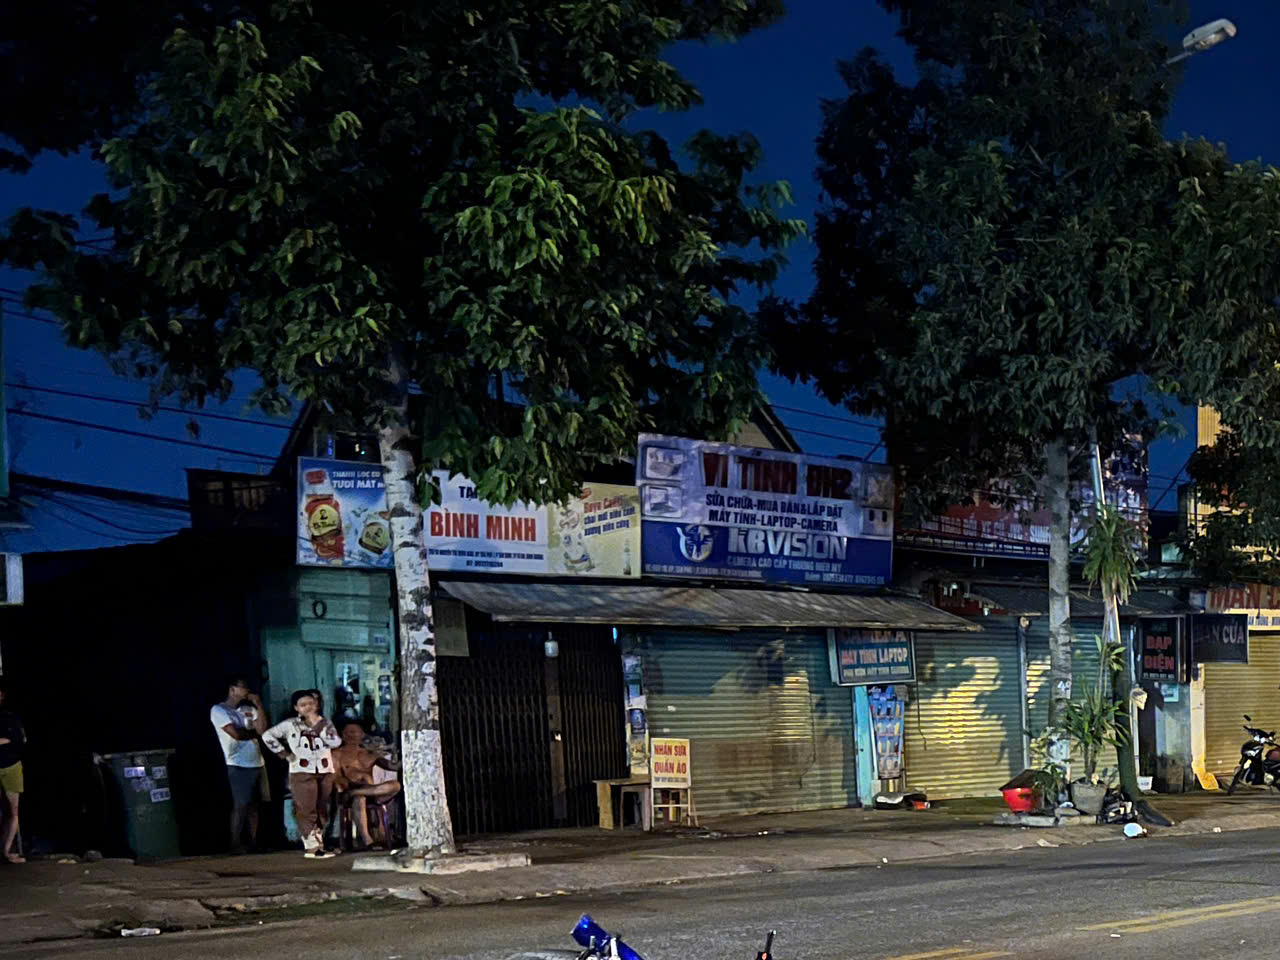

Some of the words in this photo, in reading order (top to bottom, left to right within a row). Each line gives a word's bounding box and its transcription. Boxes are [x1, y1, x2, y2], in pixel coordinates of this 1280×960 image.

[706, 491, 725, 507] SỬA
[708, 508, 730, 523] MÁY
[430, 507, 480, 538] BÌNH
[486, 515, 536, 542] MINH
[727, 527, 847, 560] KBVISION
[728, 555, 756, 568] CAMERA
[758, 557, 772, 568] CAO
[879, 647, 908, 663] LAPTOP
